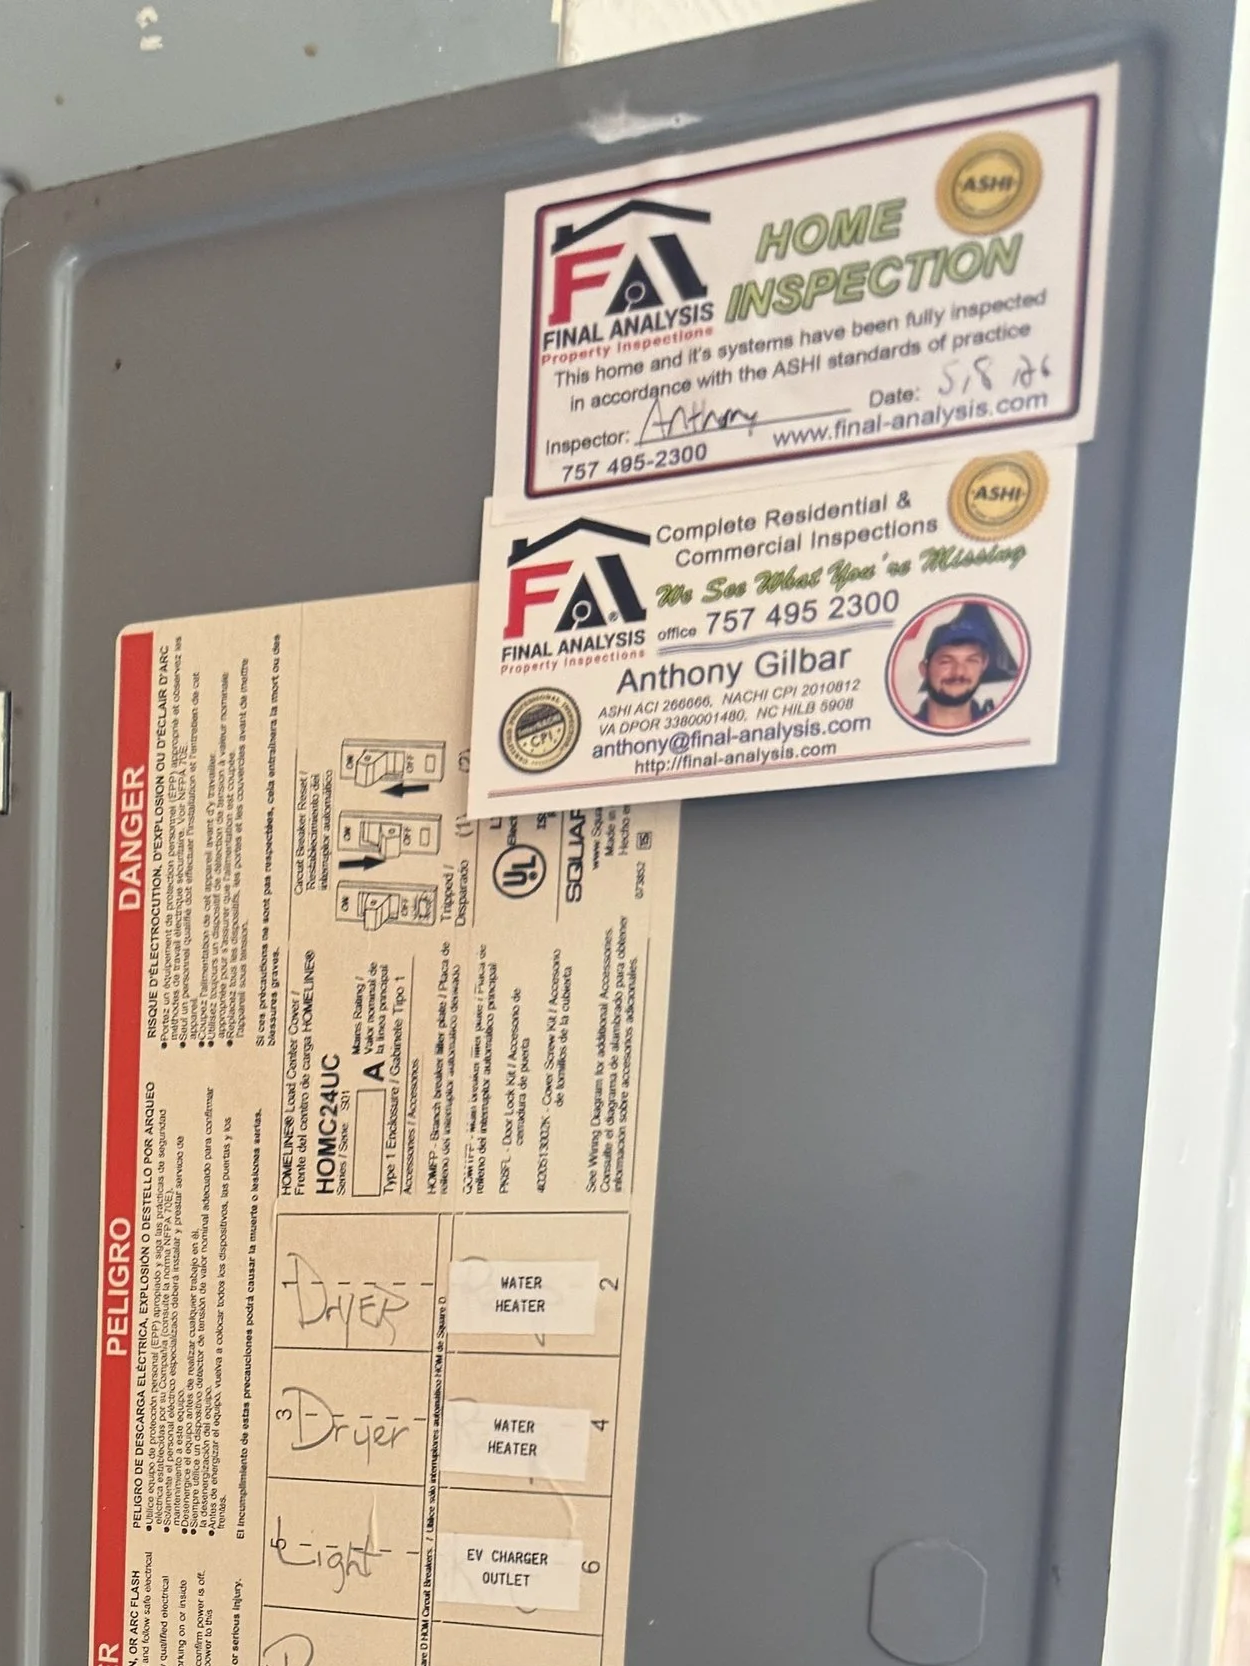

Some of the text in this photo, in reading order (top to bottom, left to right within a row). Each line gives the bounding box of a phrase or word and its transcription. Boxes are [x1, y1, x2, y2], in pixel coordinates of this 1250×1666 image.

[961, 175, 1013, 193] ASHI
[755, 197, 907, 263] HOME
[725, 233, 1023, 323] INSPECTION
[543, 302, 714, 351] FINAL ANALYSIS
[555, 288, 1047, 388] This home and it's systems have been fully inspected
[541, 325, 714, 366] Property Inspections
[570, 321, 1032, 412] in accordance with the ASHI standards of practice
[869, 387, 921, 408] Date:
[772, 391, 1048, 448] www.final-analysis.com
[546, 430, 631, 456] Inspector:
[562, 443, 708, 483] 757 495-2300
[974, 485, 1021, 503] ASHI
[656, 490, 911, 544] Complete Residential &
[675, 518, 938, 568] Commercial Inspections
[656, 583, 693, 607] We
[703, 576, 748, 603] See
[754, 565, 823, 596] What
[920, 545, 1028, 573] Missing
[657, 589, 900, 642] office 757 495 2300
[500, 649, 645, 676] Property Inspections
[501, 629, 646, 663] FINAL ANALYSIS
[617, 644, 852, 695] Anthony Gilbar
[598, 704, 634, 719] ASHI
[635, 701, 659, 715] ACI
[722, 687, 769, 706] NACHI
[773, 685, 797, 700] CPI
[592, 715, 871, 761] anthony@final-analysis.com
[600, 724, 617, 737] VA
[620, 717, 661, 734] DPOR
[756, 705, 778, 720] NC
[635, 741, 836, 776] http://final-analysis.com
[119, 765, 146, 911] DANGER
[317, 1054, 341, 1194] HOMC24UC
[106, 1216, 131, 1357] PELIGRO
[501, 1276, 542, 1291] WATER
[599, 1277, 620, 1292] 2
[494, 1299, 546, 1314] HEATER
[275, 1407, 293, 1421] 3
[282, 1386, 410, 1466] Dryer
[493, 1417, 536, 1434] WATER
[591, 1418, 610, 1433] 4
[487, 1440, 537, 1457] HEATER
[466, 1549, 549, 1566] EV CHARGER
[580, 1560, 601, 1574] 6
[130, 1570, 140, 1608] FLASH
[482, 1572, 530, 1587] OUTLET
[129, 1613, 139, 1639] ARC
[127, 1643, 138, 1659] OR
